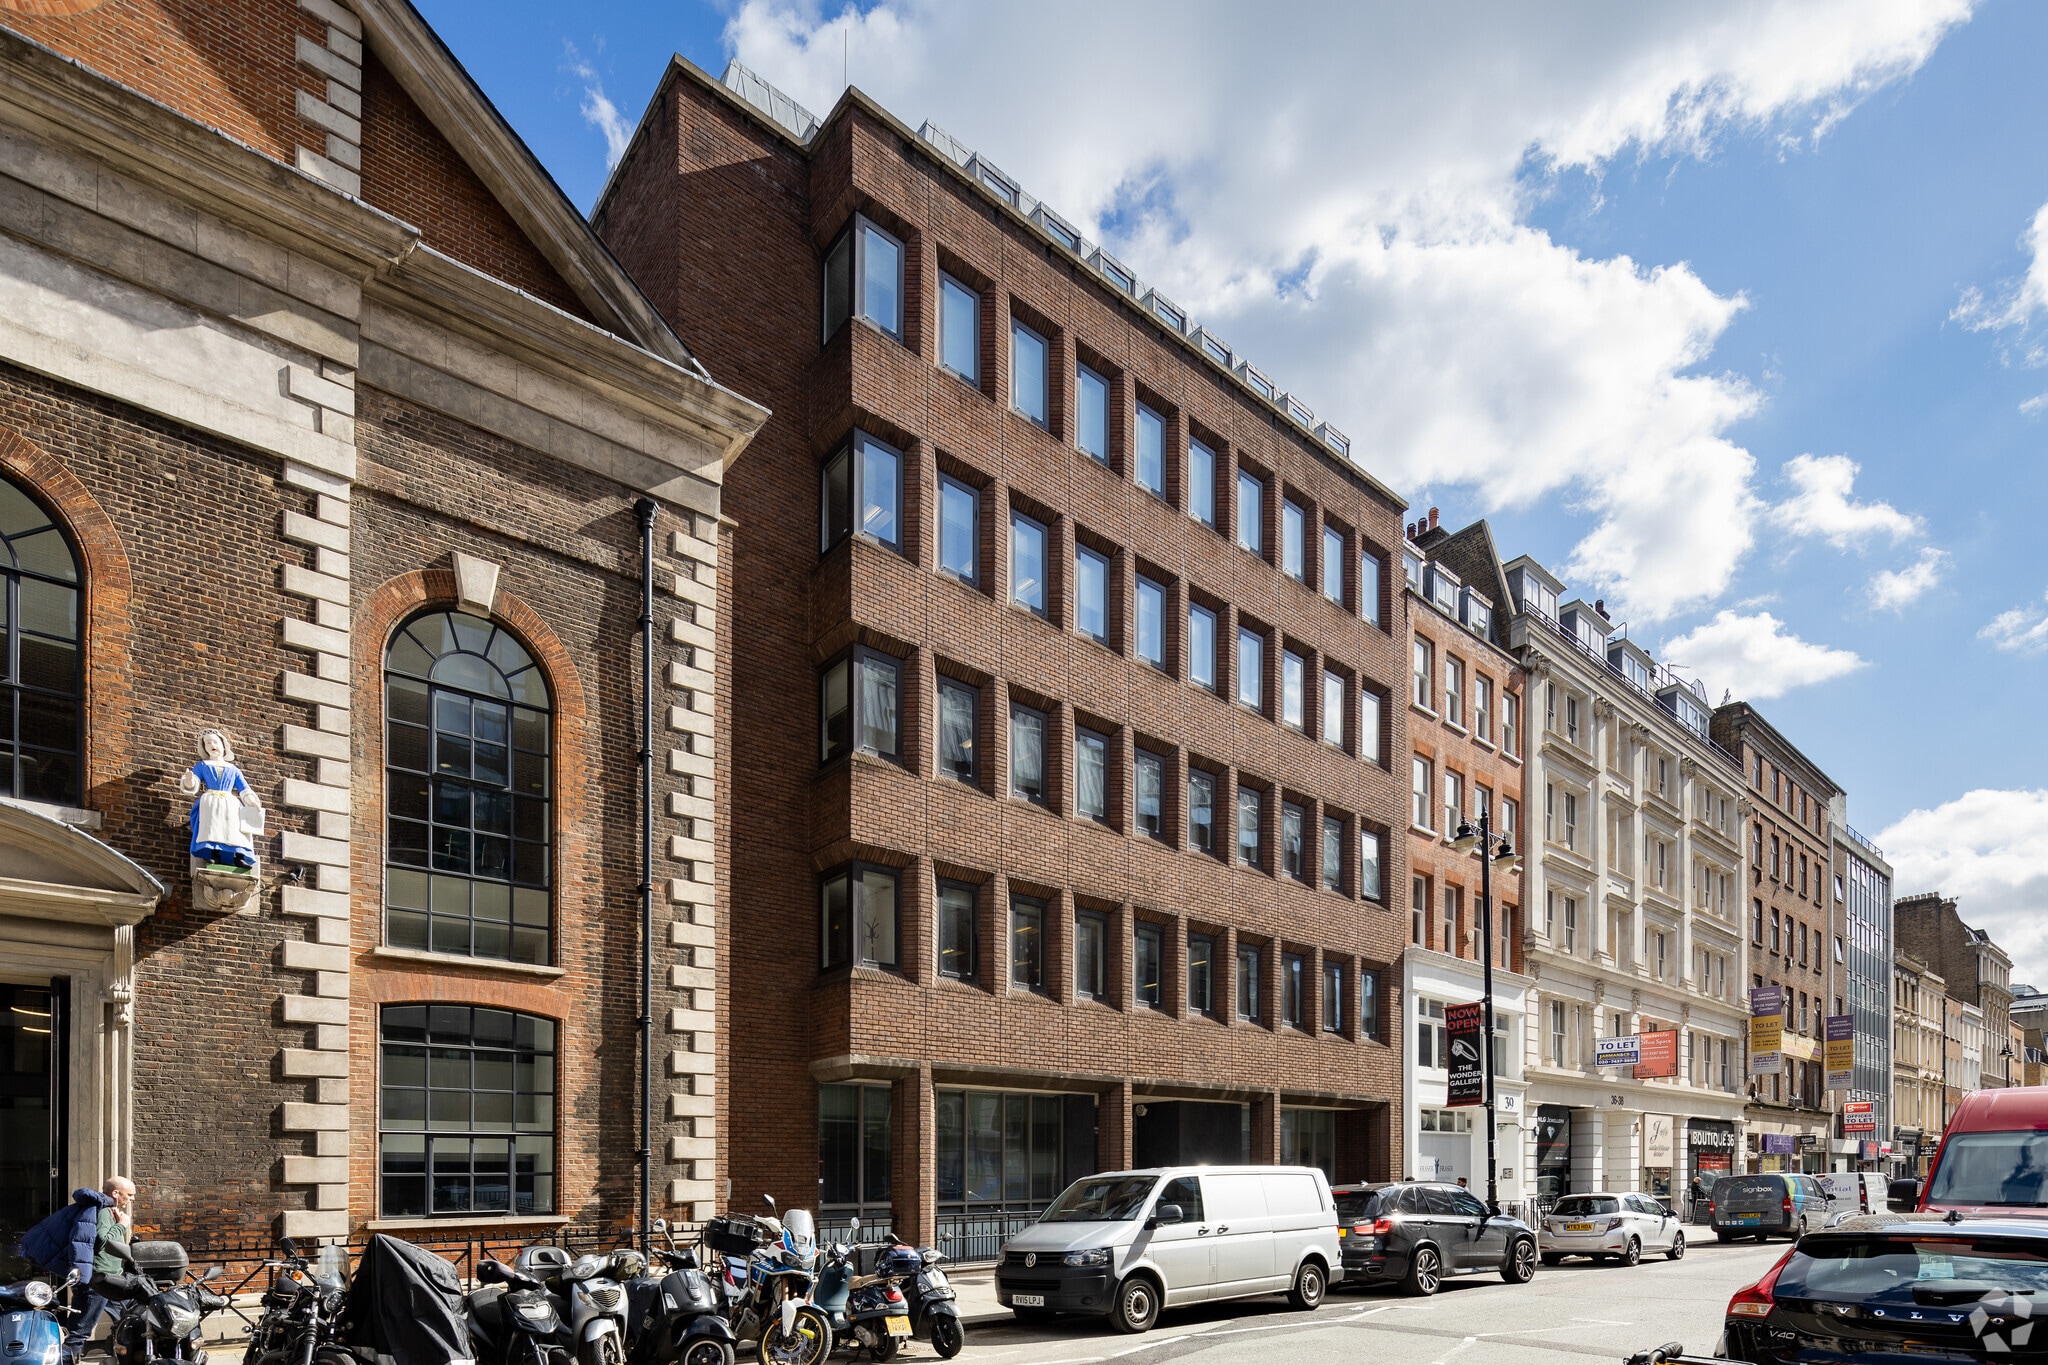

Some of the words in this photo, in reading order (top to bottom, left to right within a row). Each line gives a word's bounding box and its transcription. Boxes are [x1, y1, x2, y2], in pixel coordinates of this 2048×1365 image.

[1448, 1007, 1480, 1020] NOW
[1447, 1017, 1480, 1030] OPEN
[1617, 1041, 1635, 1049] LET
[1449, 1071, 1482, 1080] WONDER
[1450, 1078, 1481, 1087] GALLERY
[1505, 1096, 1514, 1110] 39
[1611, 1095, 1624, 1106] 36-38
[1693, 1131, 1727, 1147] BOUTIQUE
[1727, 1133, 1735, 1146] 36
[1742, 1186, 1773, 1194] signbox
[1028, 1297, 1041, 1305] LPJ
[1837, 1306, 2005, 1326] VOLVO
[1769, 1330, 1796, 1340] V40
